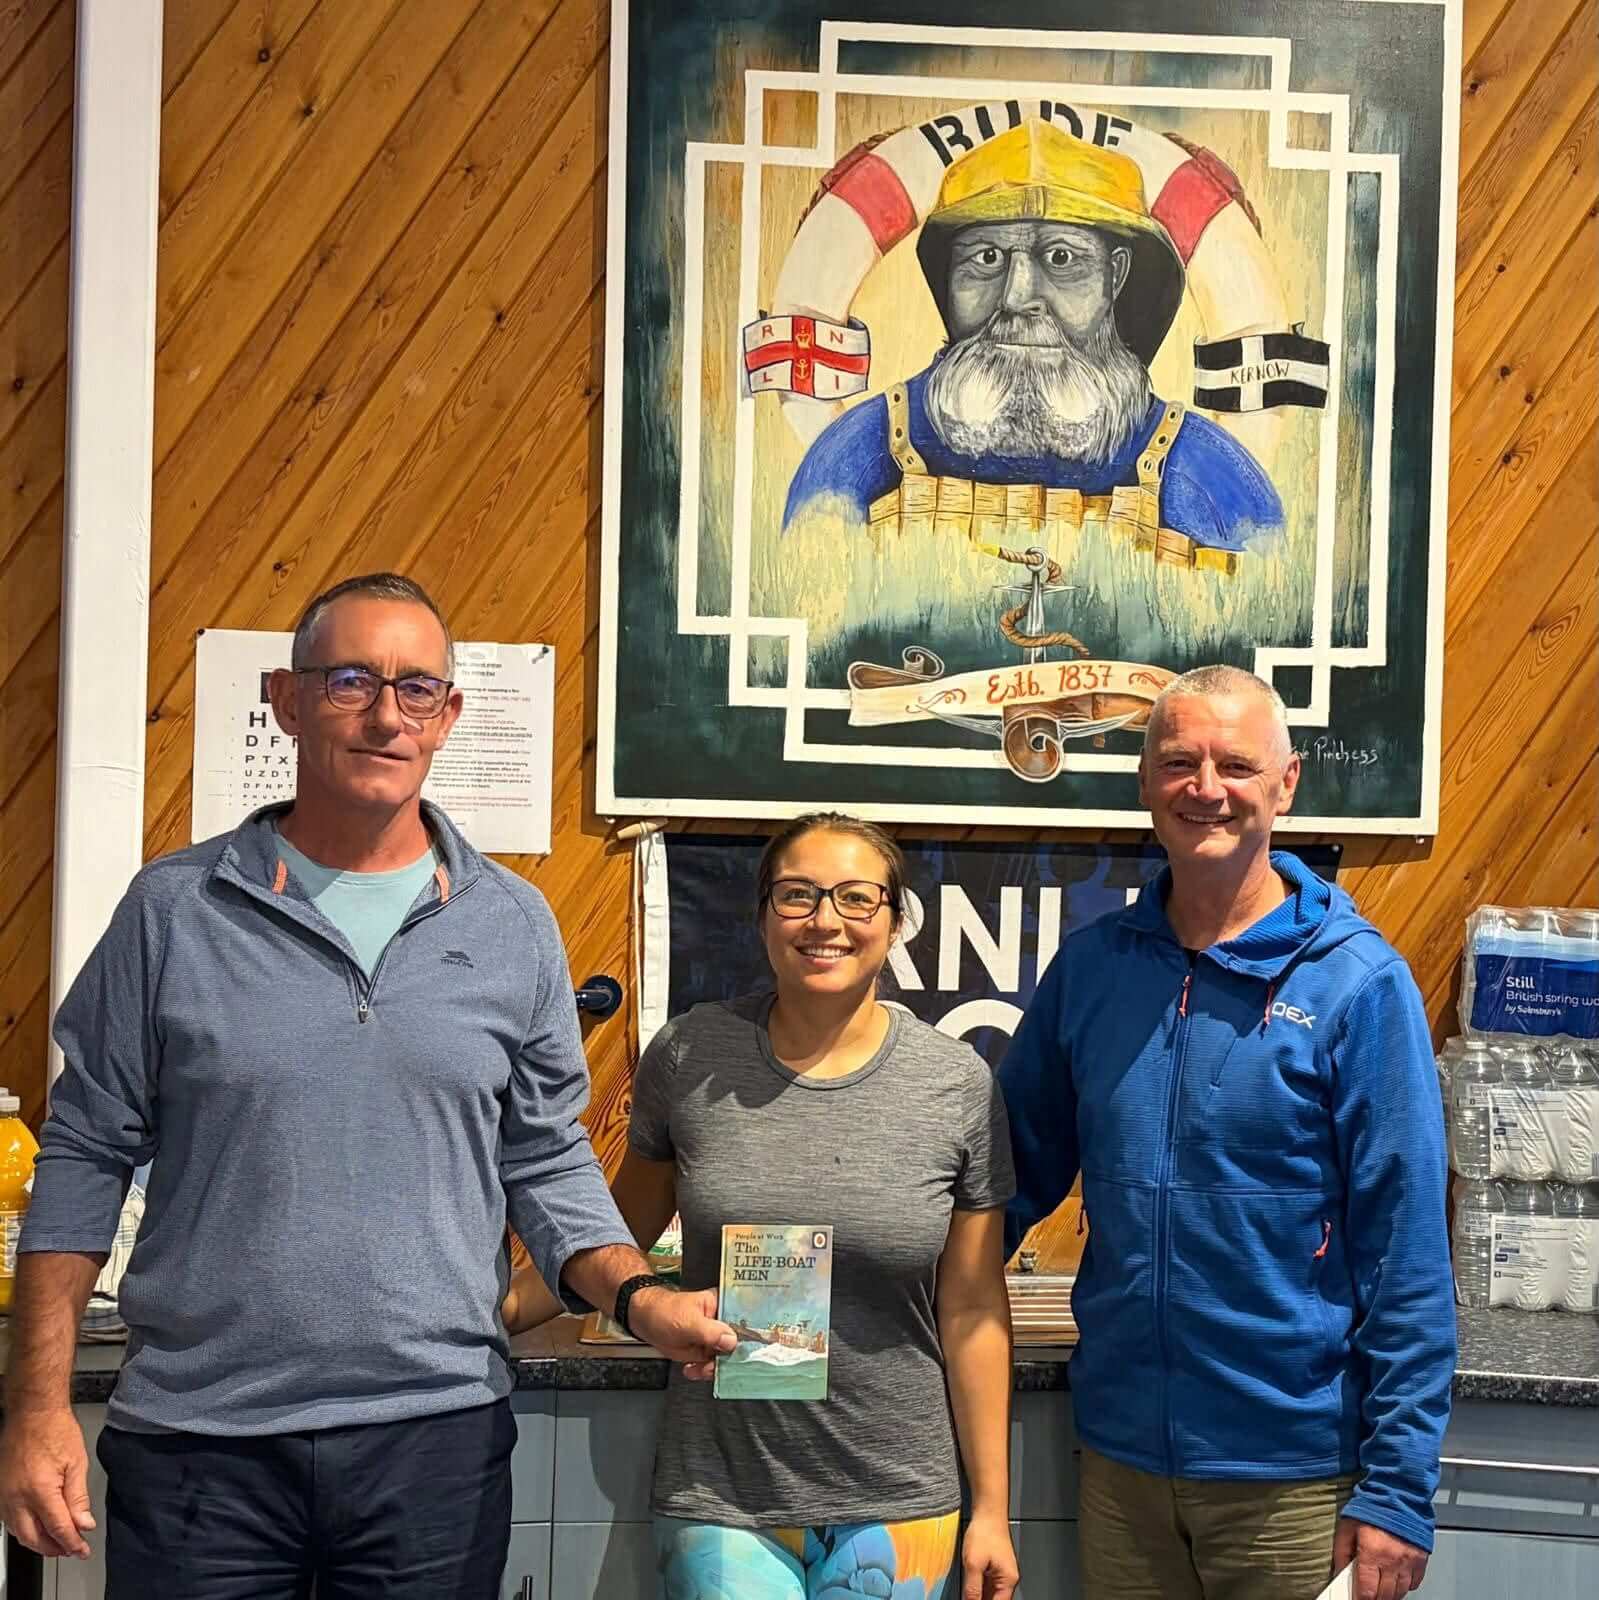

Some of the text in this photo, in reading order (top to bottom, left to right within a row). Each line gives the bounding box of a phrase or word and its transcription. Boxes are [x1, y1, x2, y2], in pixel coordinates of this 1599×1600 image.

[761, 324, 844, 344] R N
[1058, 663, 1113, 692] 1837
[1505, 976, 1535, 989] Still
[1506, 990, 1543, 1002] British
[1545, 994, 1579, 1008] spring
[1505, 1003, 1561, 1016] by Sainsbury's
[734, 1241, 760, 1254] The
[733, 1269, 770, 1281] MEN
[1231, 1361, 1290, 1385] KERNOW
